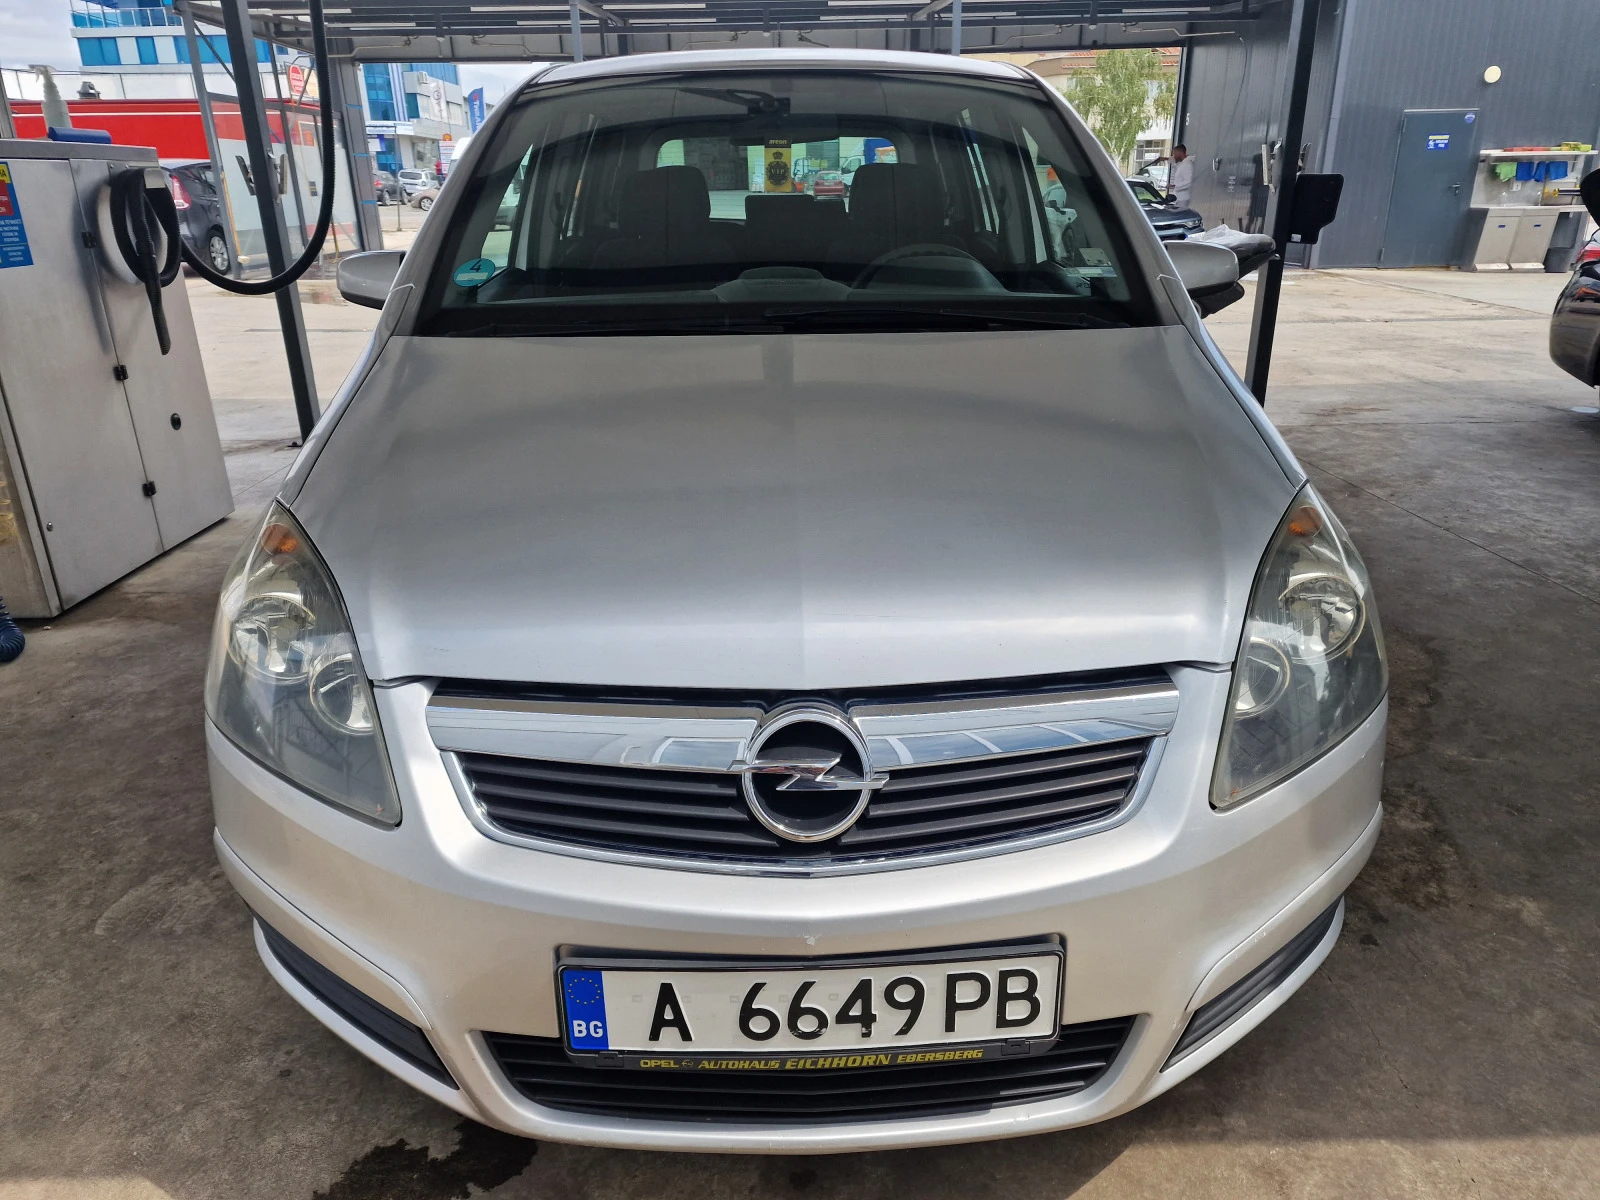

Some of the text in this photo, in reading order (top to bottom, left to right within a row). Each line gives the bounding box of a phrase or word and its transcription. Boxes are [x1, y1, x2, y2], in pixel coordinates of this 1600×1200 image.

[470, 259, 482, 272] 4
[573, 968, 1041, 1042] BG A 6649 PB
[640, 1049, 984, 1070] OPEL AUTOHAUS EICHHORN EBERSBERG
